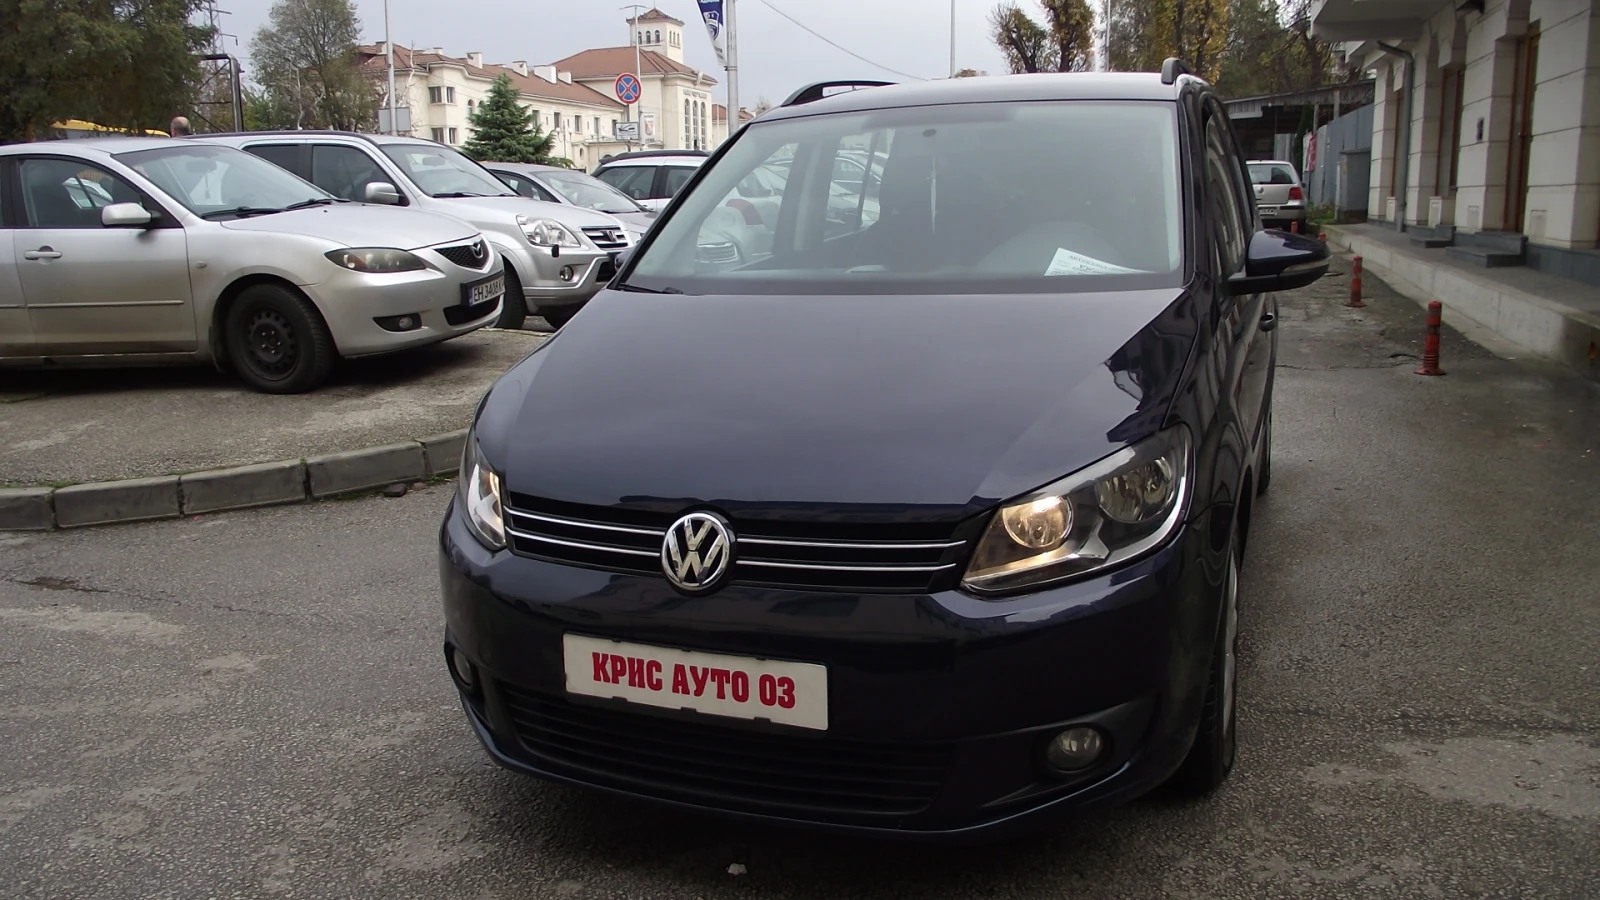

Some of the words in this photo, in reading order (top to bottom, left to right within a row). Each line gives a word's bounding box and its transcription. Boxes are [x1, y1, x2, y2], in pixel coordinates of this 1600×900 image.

[592, 652, 663, 691] КРИС
[672, 664, 750, 703] АУТО
[758, 674, 796, 709] 03
